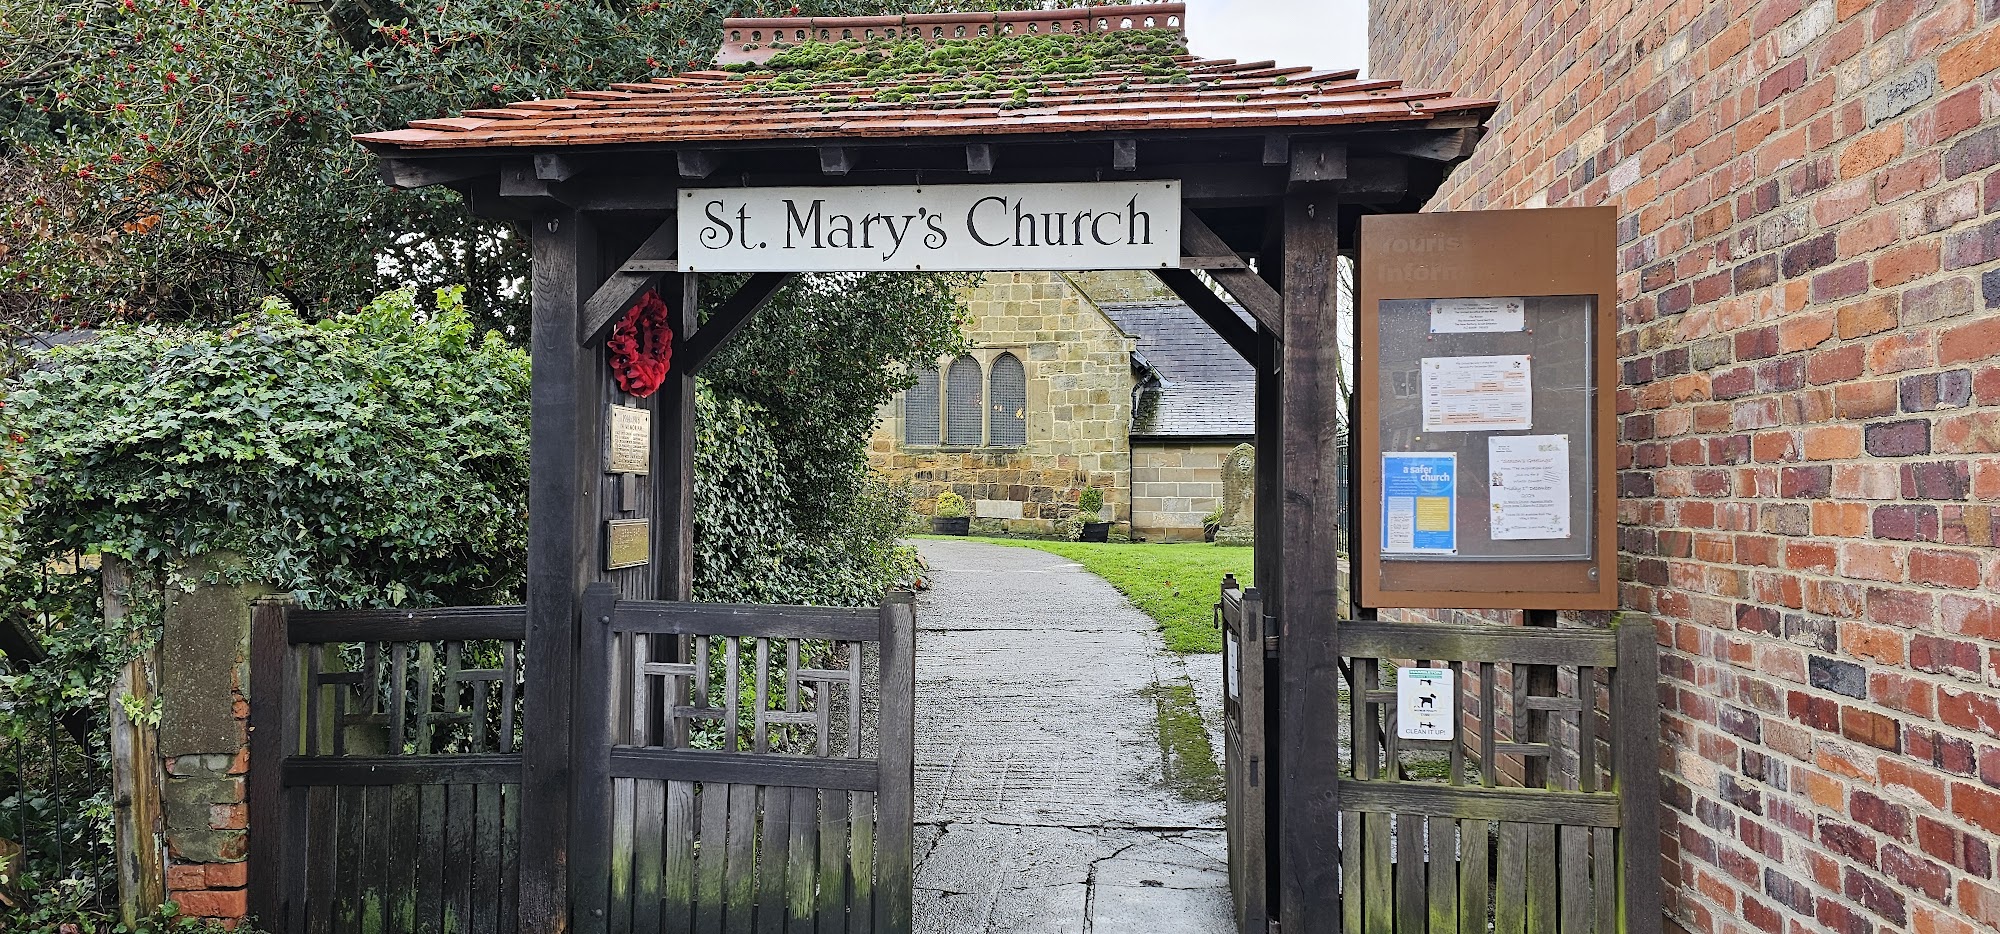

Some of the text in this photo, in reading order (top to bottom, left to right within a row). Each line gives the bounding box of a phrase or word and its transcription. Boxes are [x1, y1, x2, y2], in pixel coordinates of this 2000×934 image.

[700, 193, 1153, 262] St. Mary's Church
[1403, 464, 1433, 474] a safer
[1420, 472, 1450, 482] church
